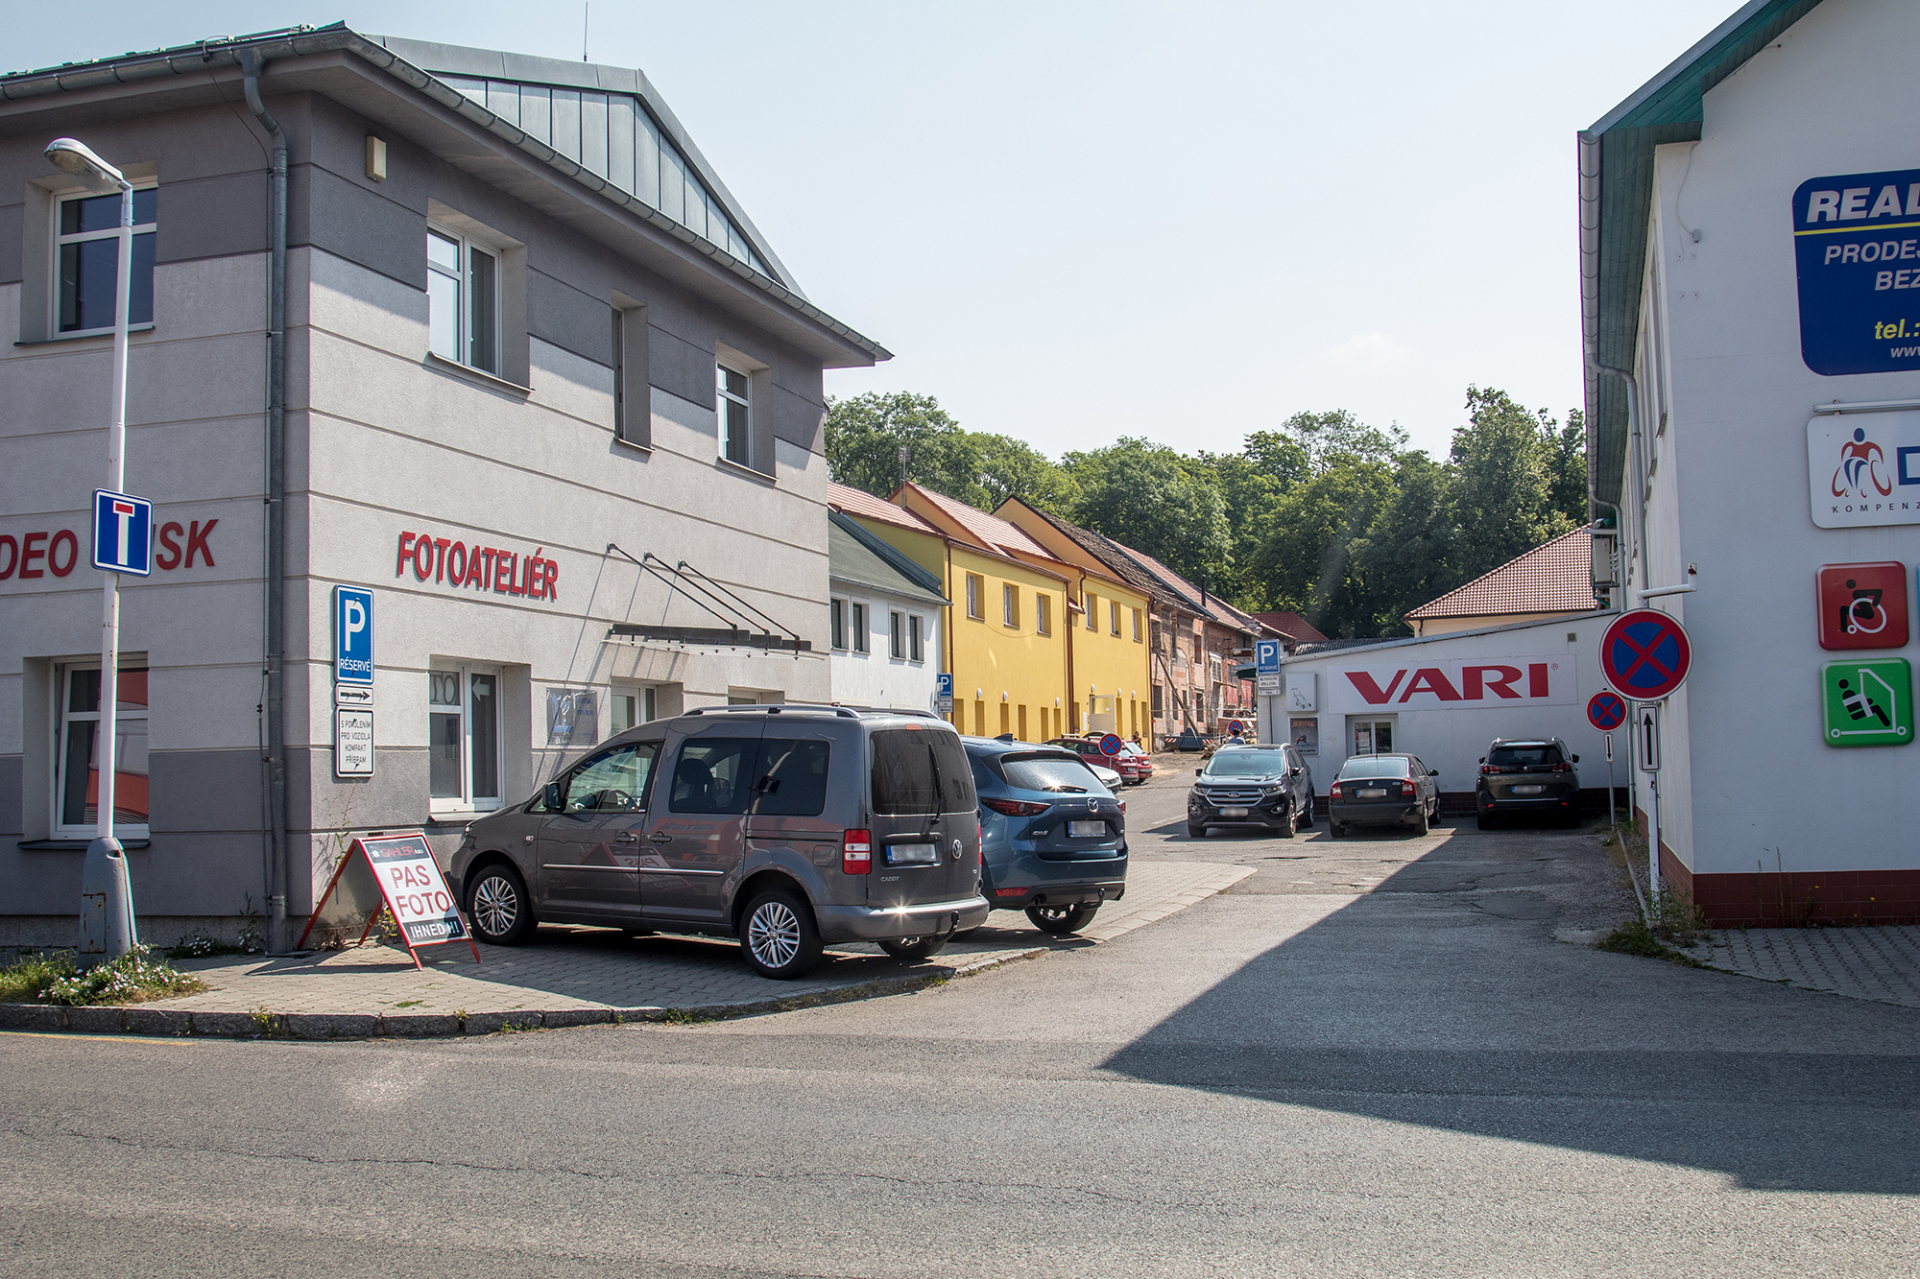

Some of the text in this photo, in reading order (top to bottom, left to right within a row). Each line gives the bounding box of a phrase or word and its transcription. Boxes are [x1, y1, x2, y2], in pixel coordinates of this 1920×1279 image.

[1890, 346, 1920, 358] ww
[153, 519, 219, 570] SK
[397, 531, 559, 602] FOTOATELIÉR
[344, 599, 366, 652] P
[340, 656, 371, 673] RÉSERVÉ
[1260, 644, 1275, 665] P
[940, 676, 950, 691] P
[1344, 663, 1549, 705] VARI
[390, 864, 431, 889] PAS
[395, 891, 450, 917] FOTO
[409, 922, 446, 938] IHNED
